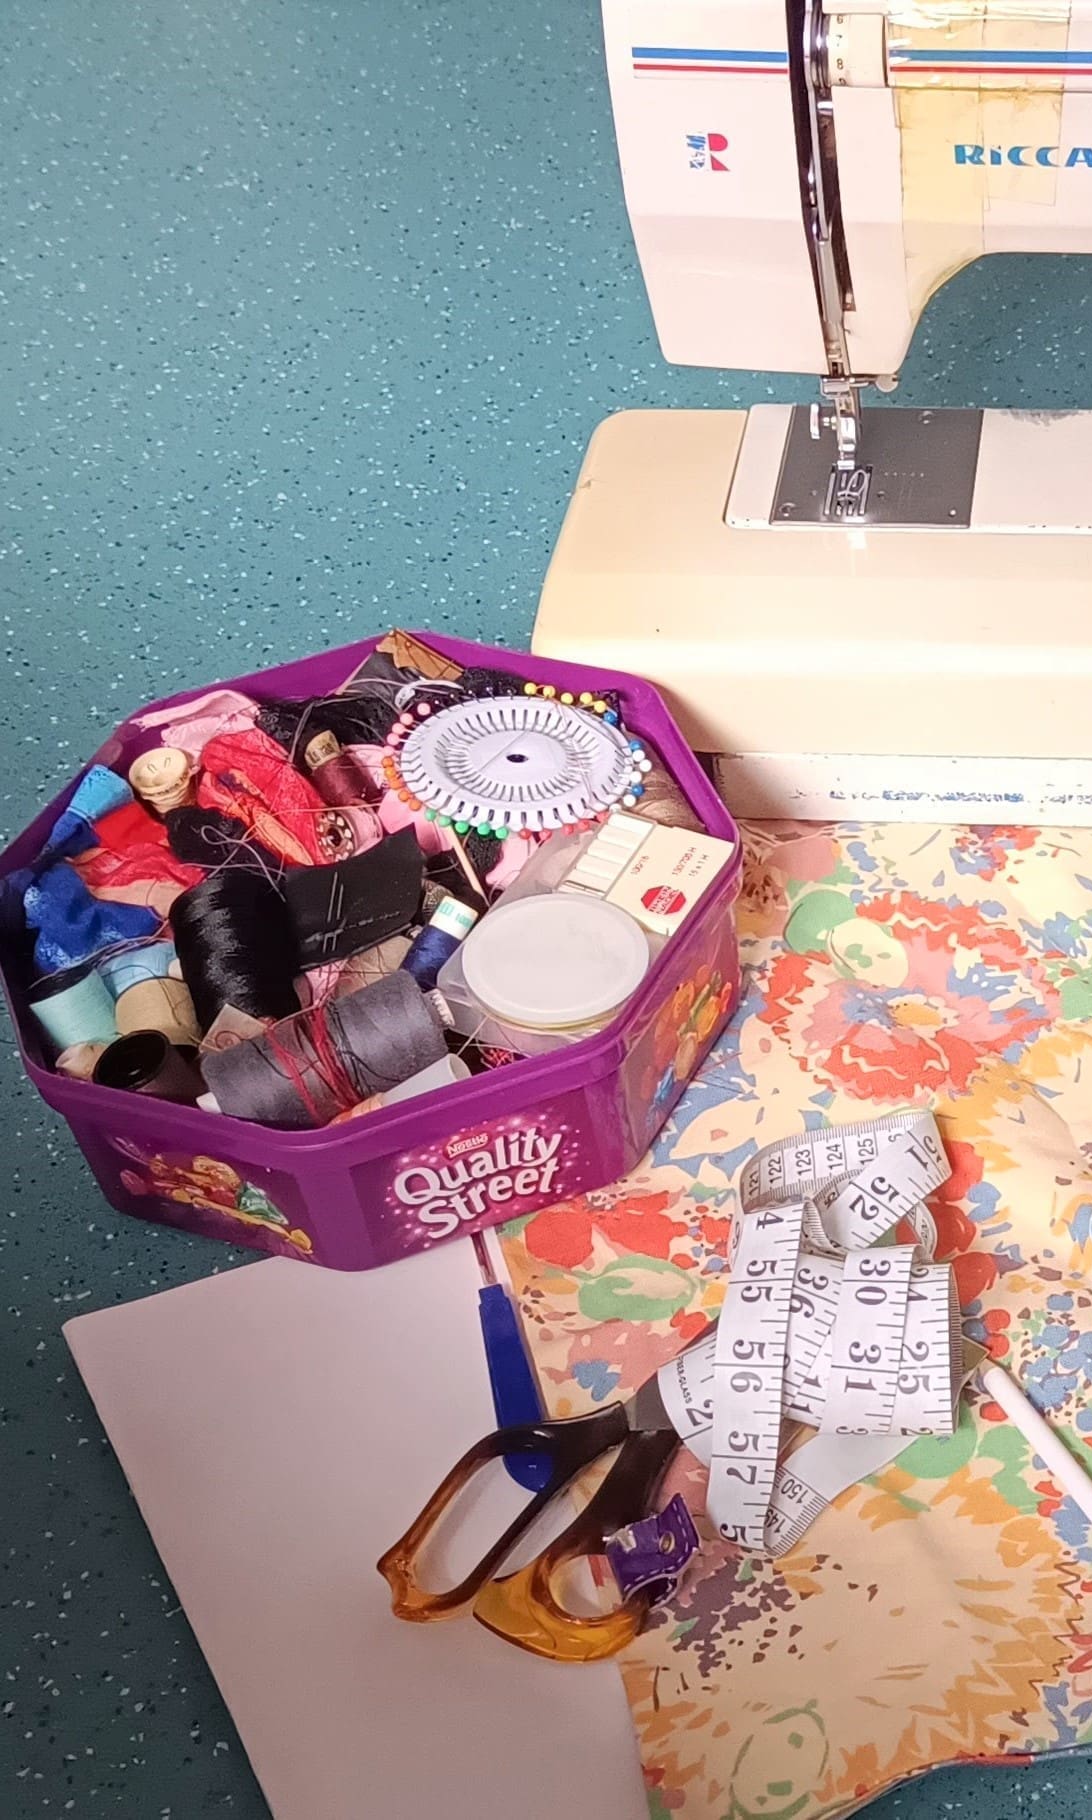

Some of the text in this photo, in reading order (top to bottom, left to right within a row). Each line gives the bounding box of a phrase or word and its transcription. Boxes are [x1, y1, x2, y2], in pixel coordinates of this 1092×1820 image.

[836, 58, 844, 71] 8
[393, 1127, 562, 1206] Quality
[768, 1156, 783, 1185] 122
[797, 1148, 812, 1177] 123
[826, 1143, 844, 1171] 124
[857, 1137, 875, 1166] 125
[418, 1157, 560, 1239] Street
[848, 1176, 900, 1221] 52
[740, 1259, 778, 1303] 55
[854, 1259, 892, 1306] 30
[729, 1338, 766, 1393] 56
[844, 1341, 882, 1393] 31
[726, 1430, 760, 1486] 57
[781, 1476, 808, 1505] 150
